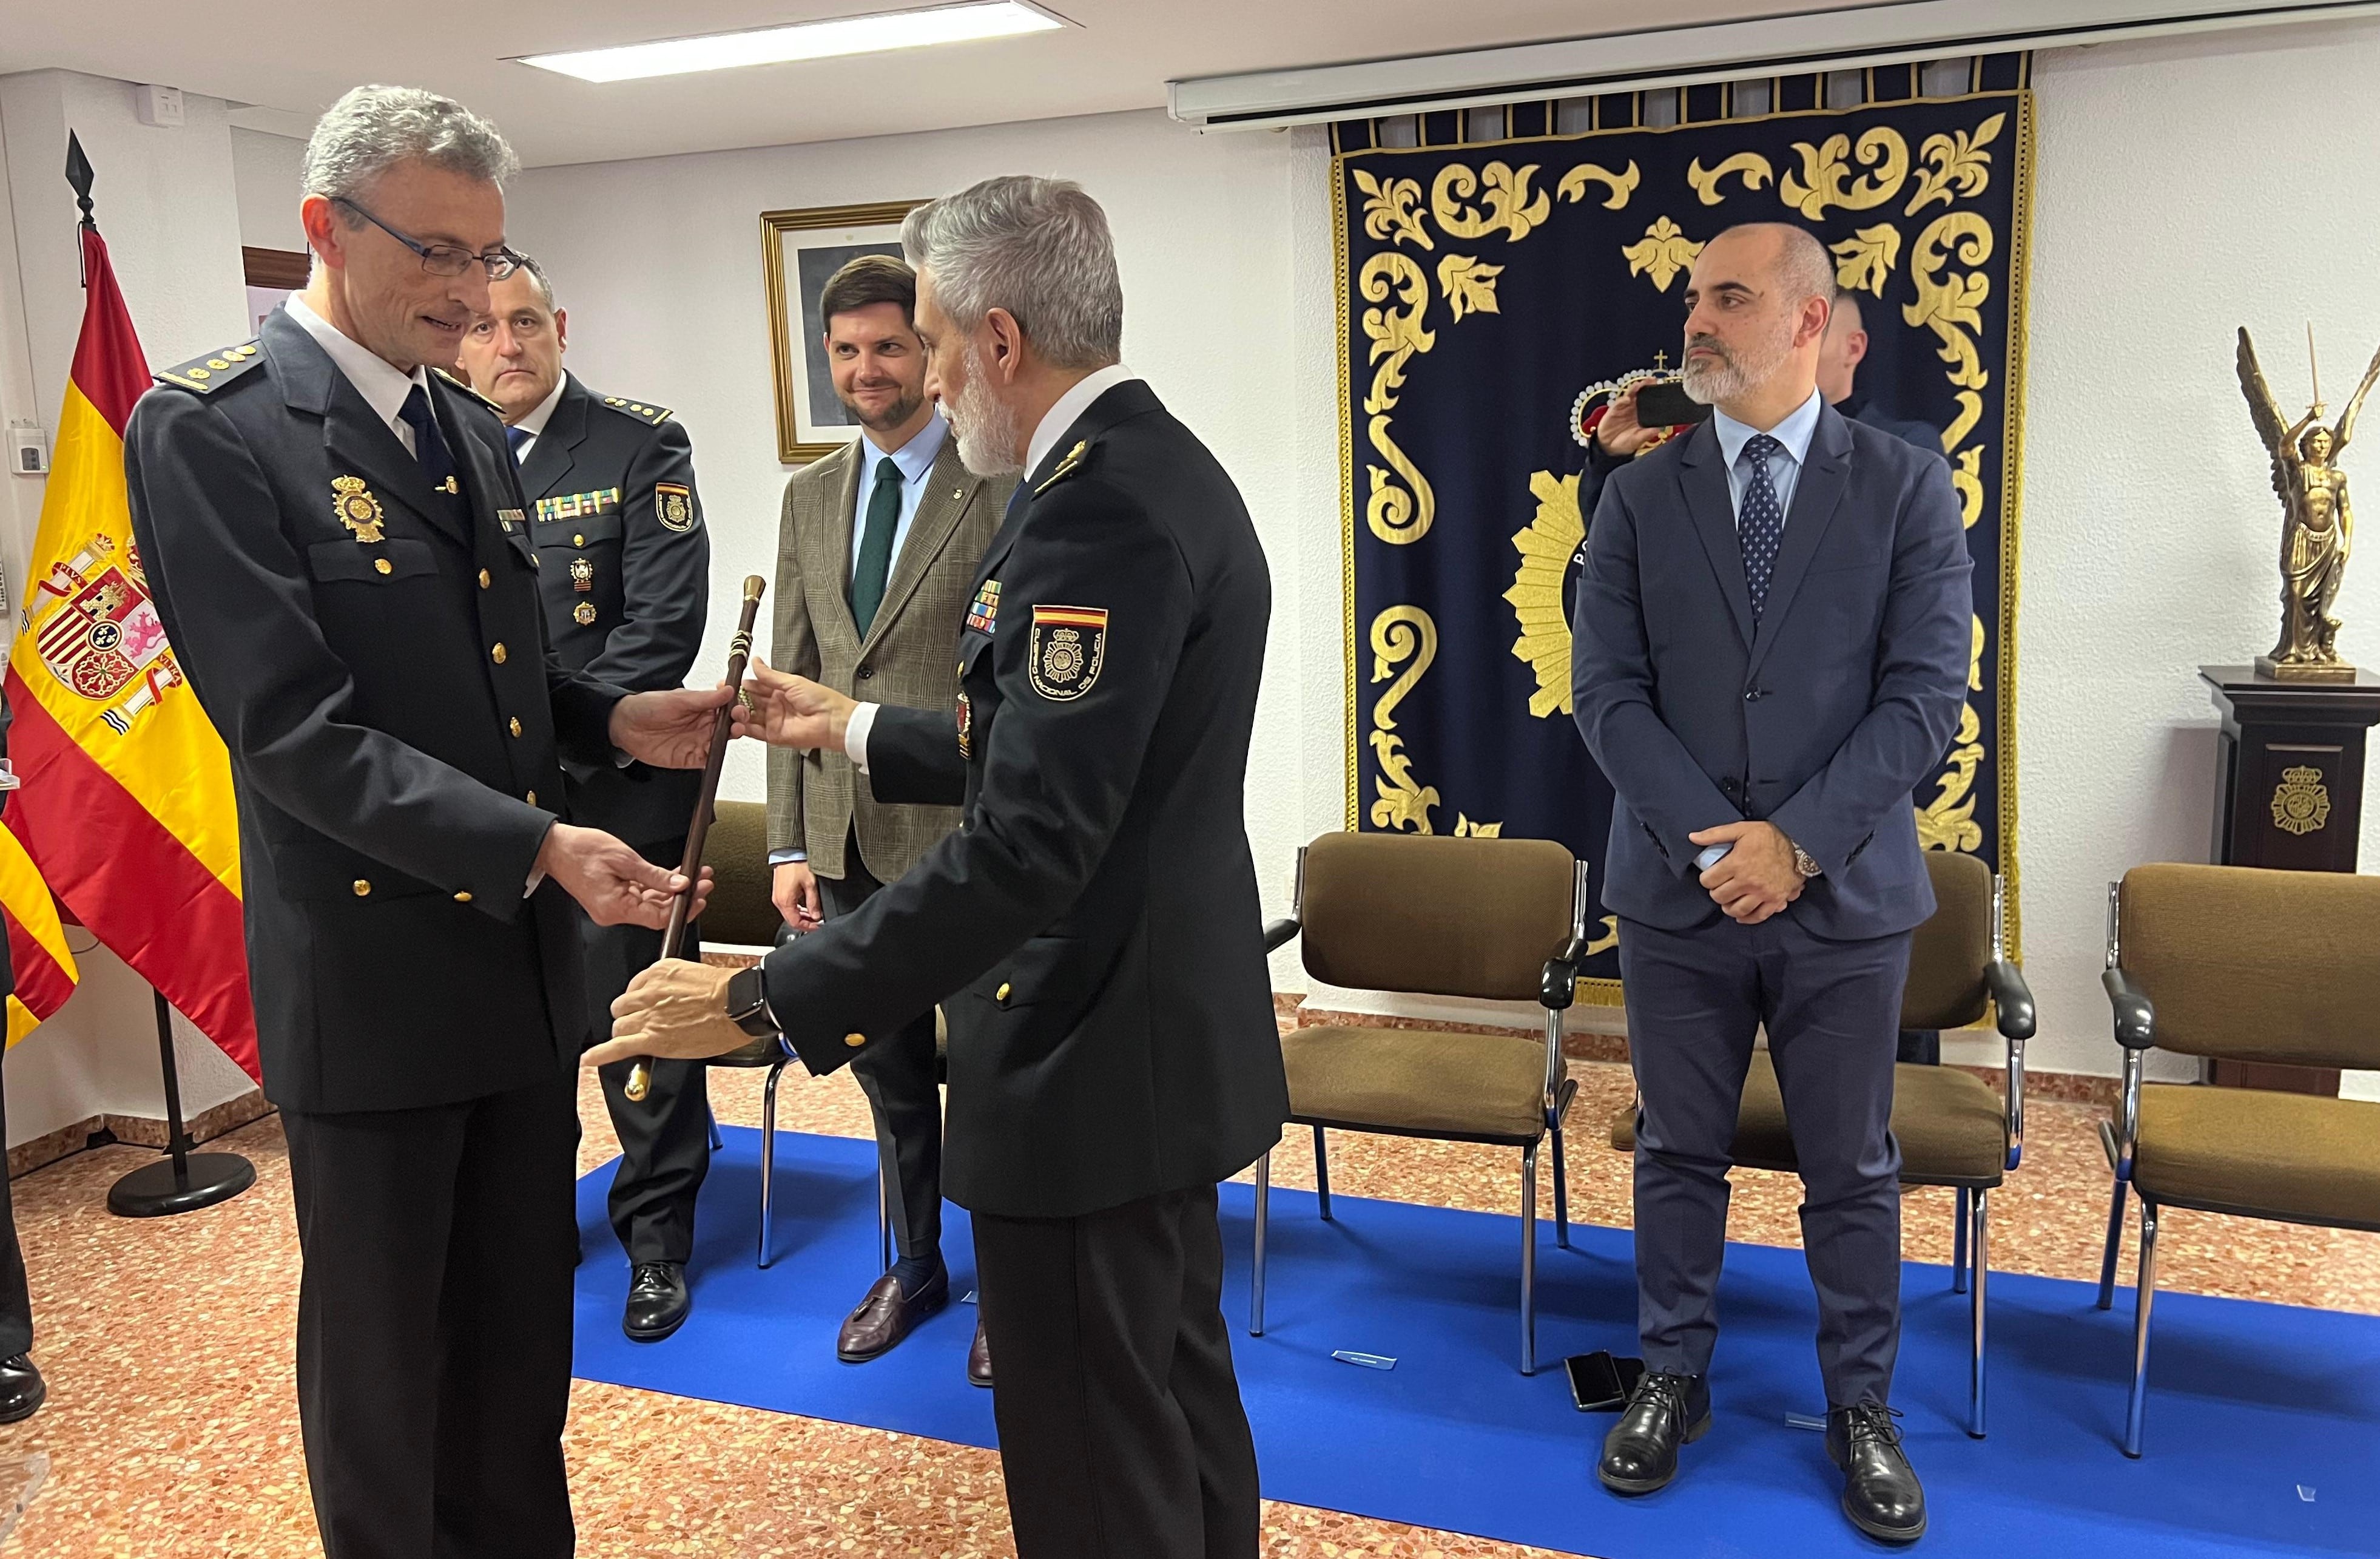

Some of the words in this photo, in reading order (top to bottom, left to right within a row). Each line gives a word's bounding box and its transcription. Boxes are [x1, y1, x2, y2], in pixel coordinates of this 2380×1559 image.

[59, 564, 81, 583] PLVS
[160, 655, 181, 681] VLTRA
[1034, 675, 1077, 696] NACIONAL
[1078, 676, 1092, 689] DE
